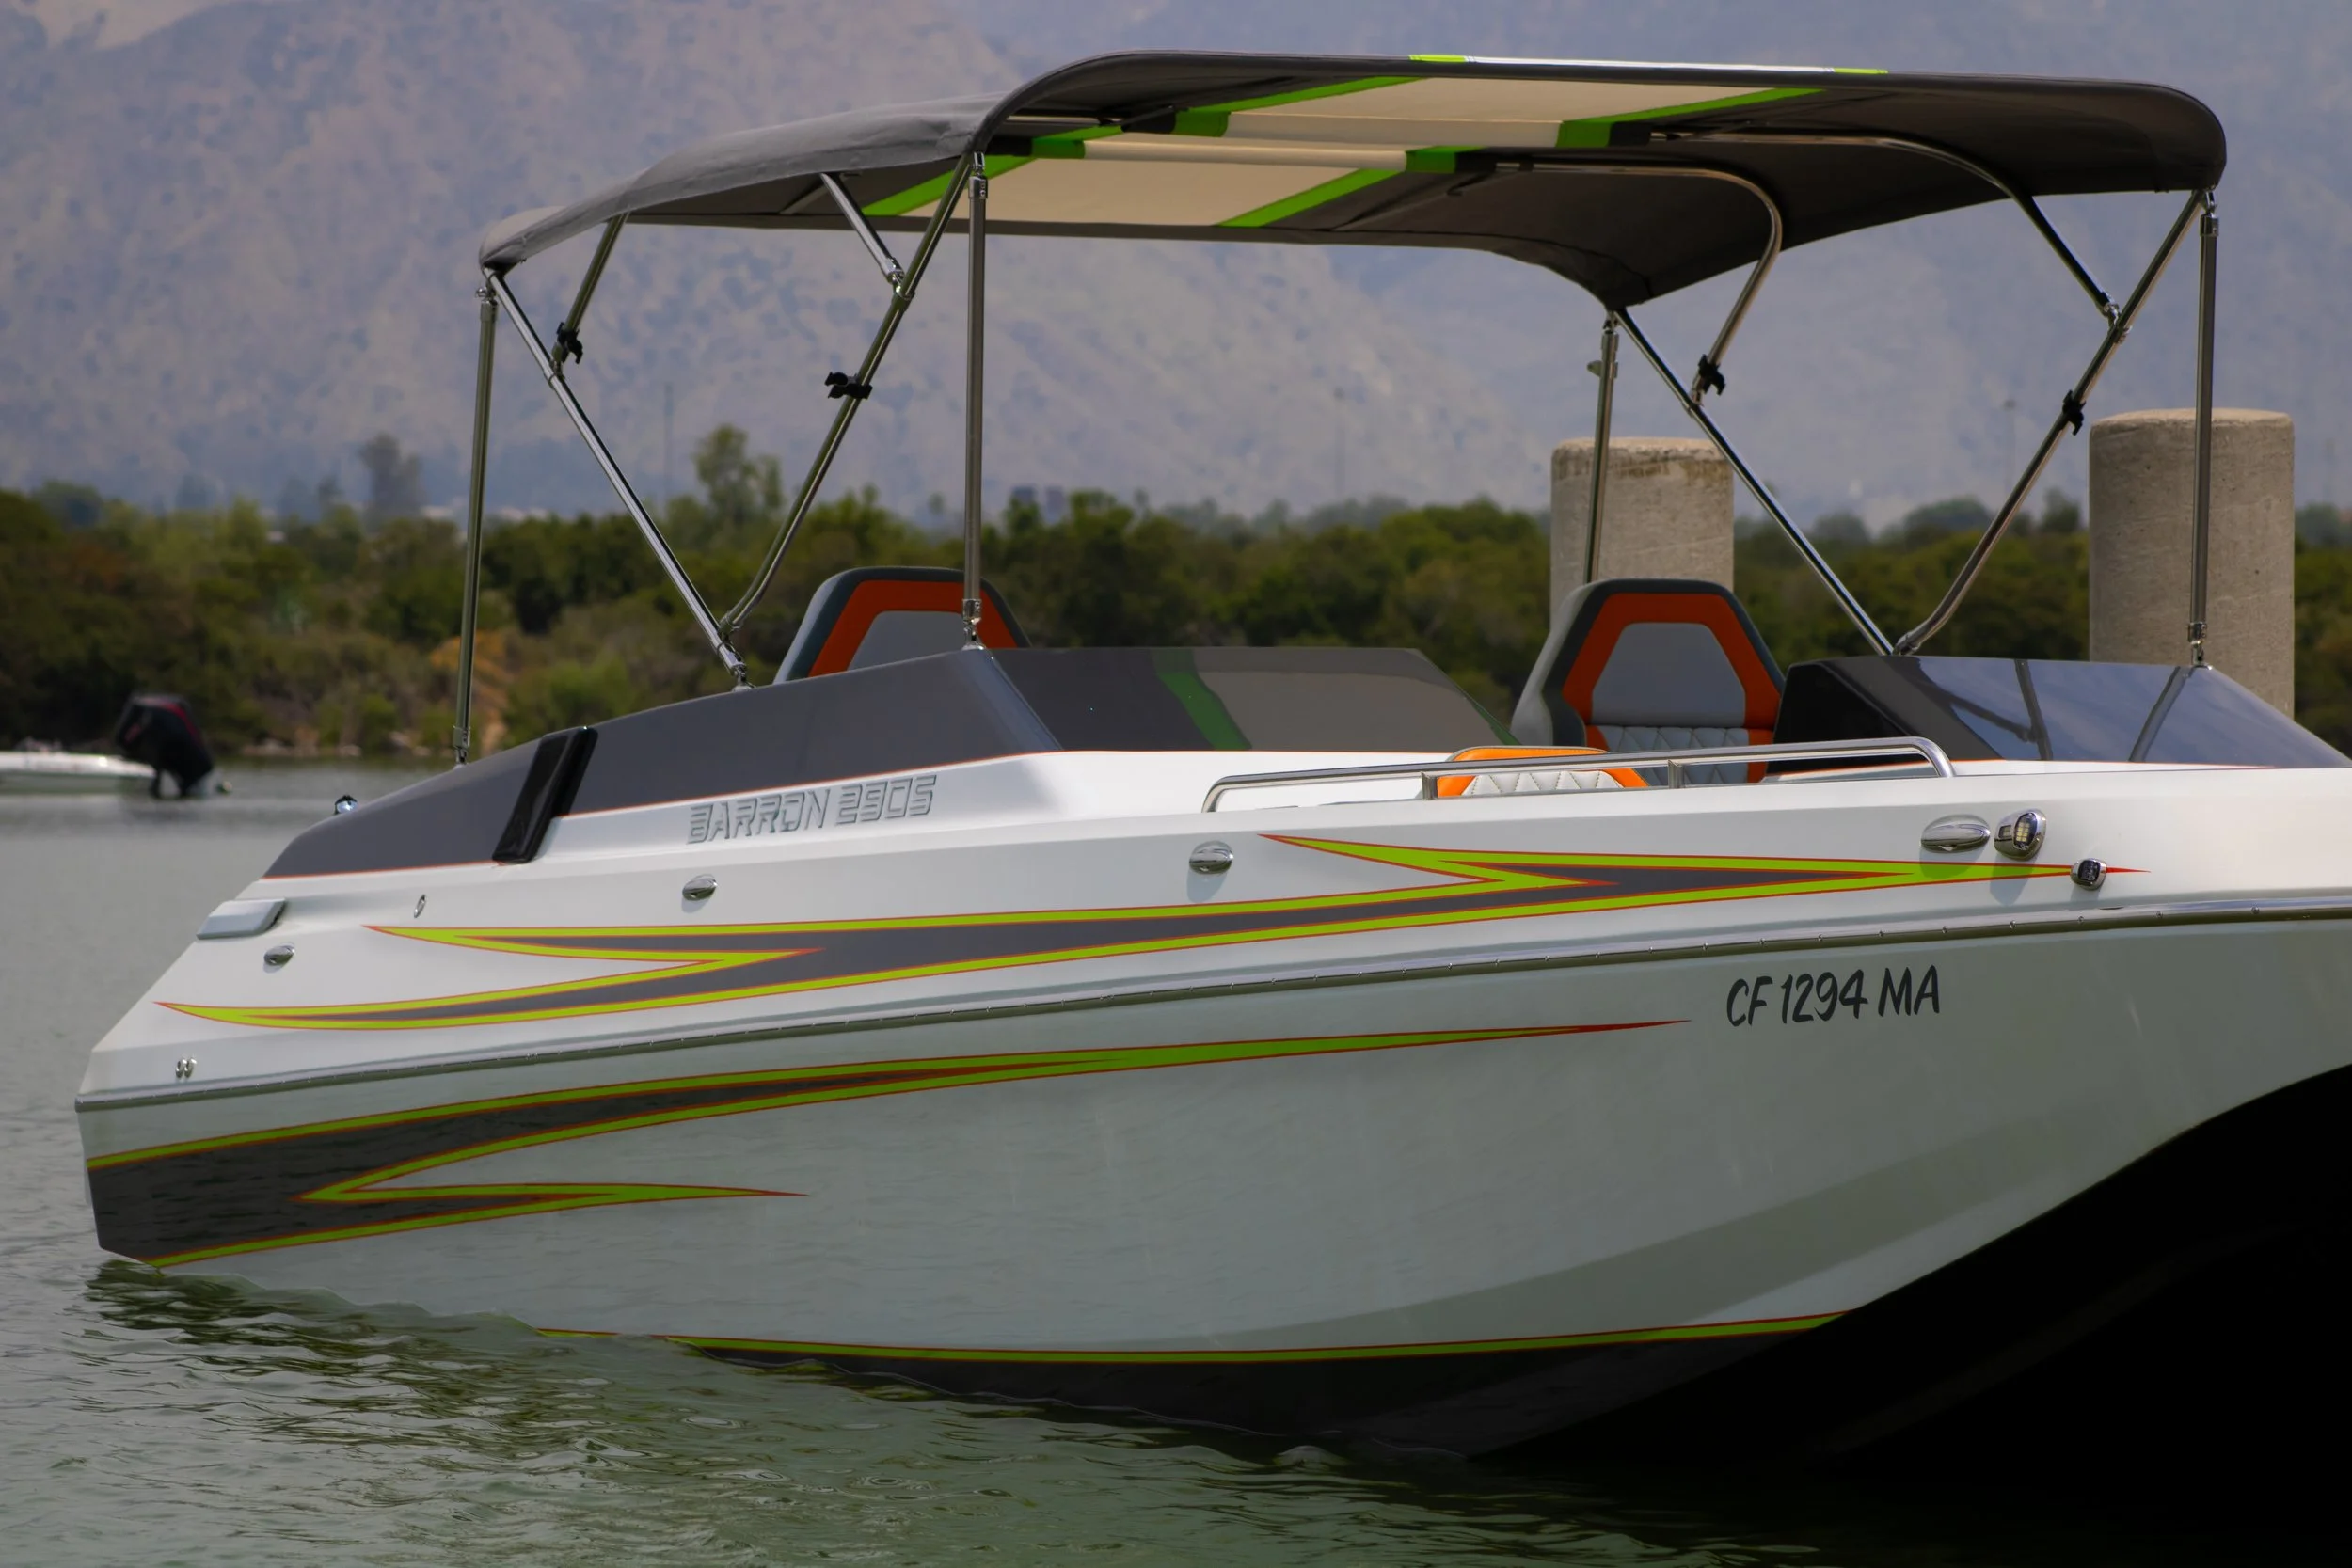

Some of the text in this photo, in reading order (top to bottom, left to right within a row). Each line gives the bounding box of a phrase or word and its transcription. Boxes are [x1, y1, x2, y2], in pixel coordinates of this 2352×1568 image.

[1726, 964, 1940, 1027] CF 1294 MA
